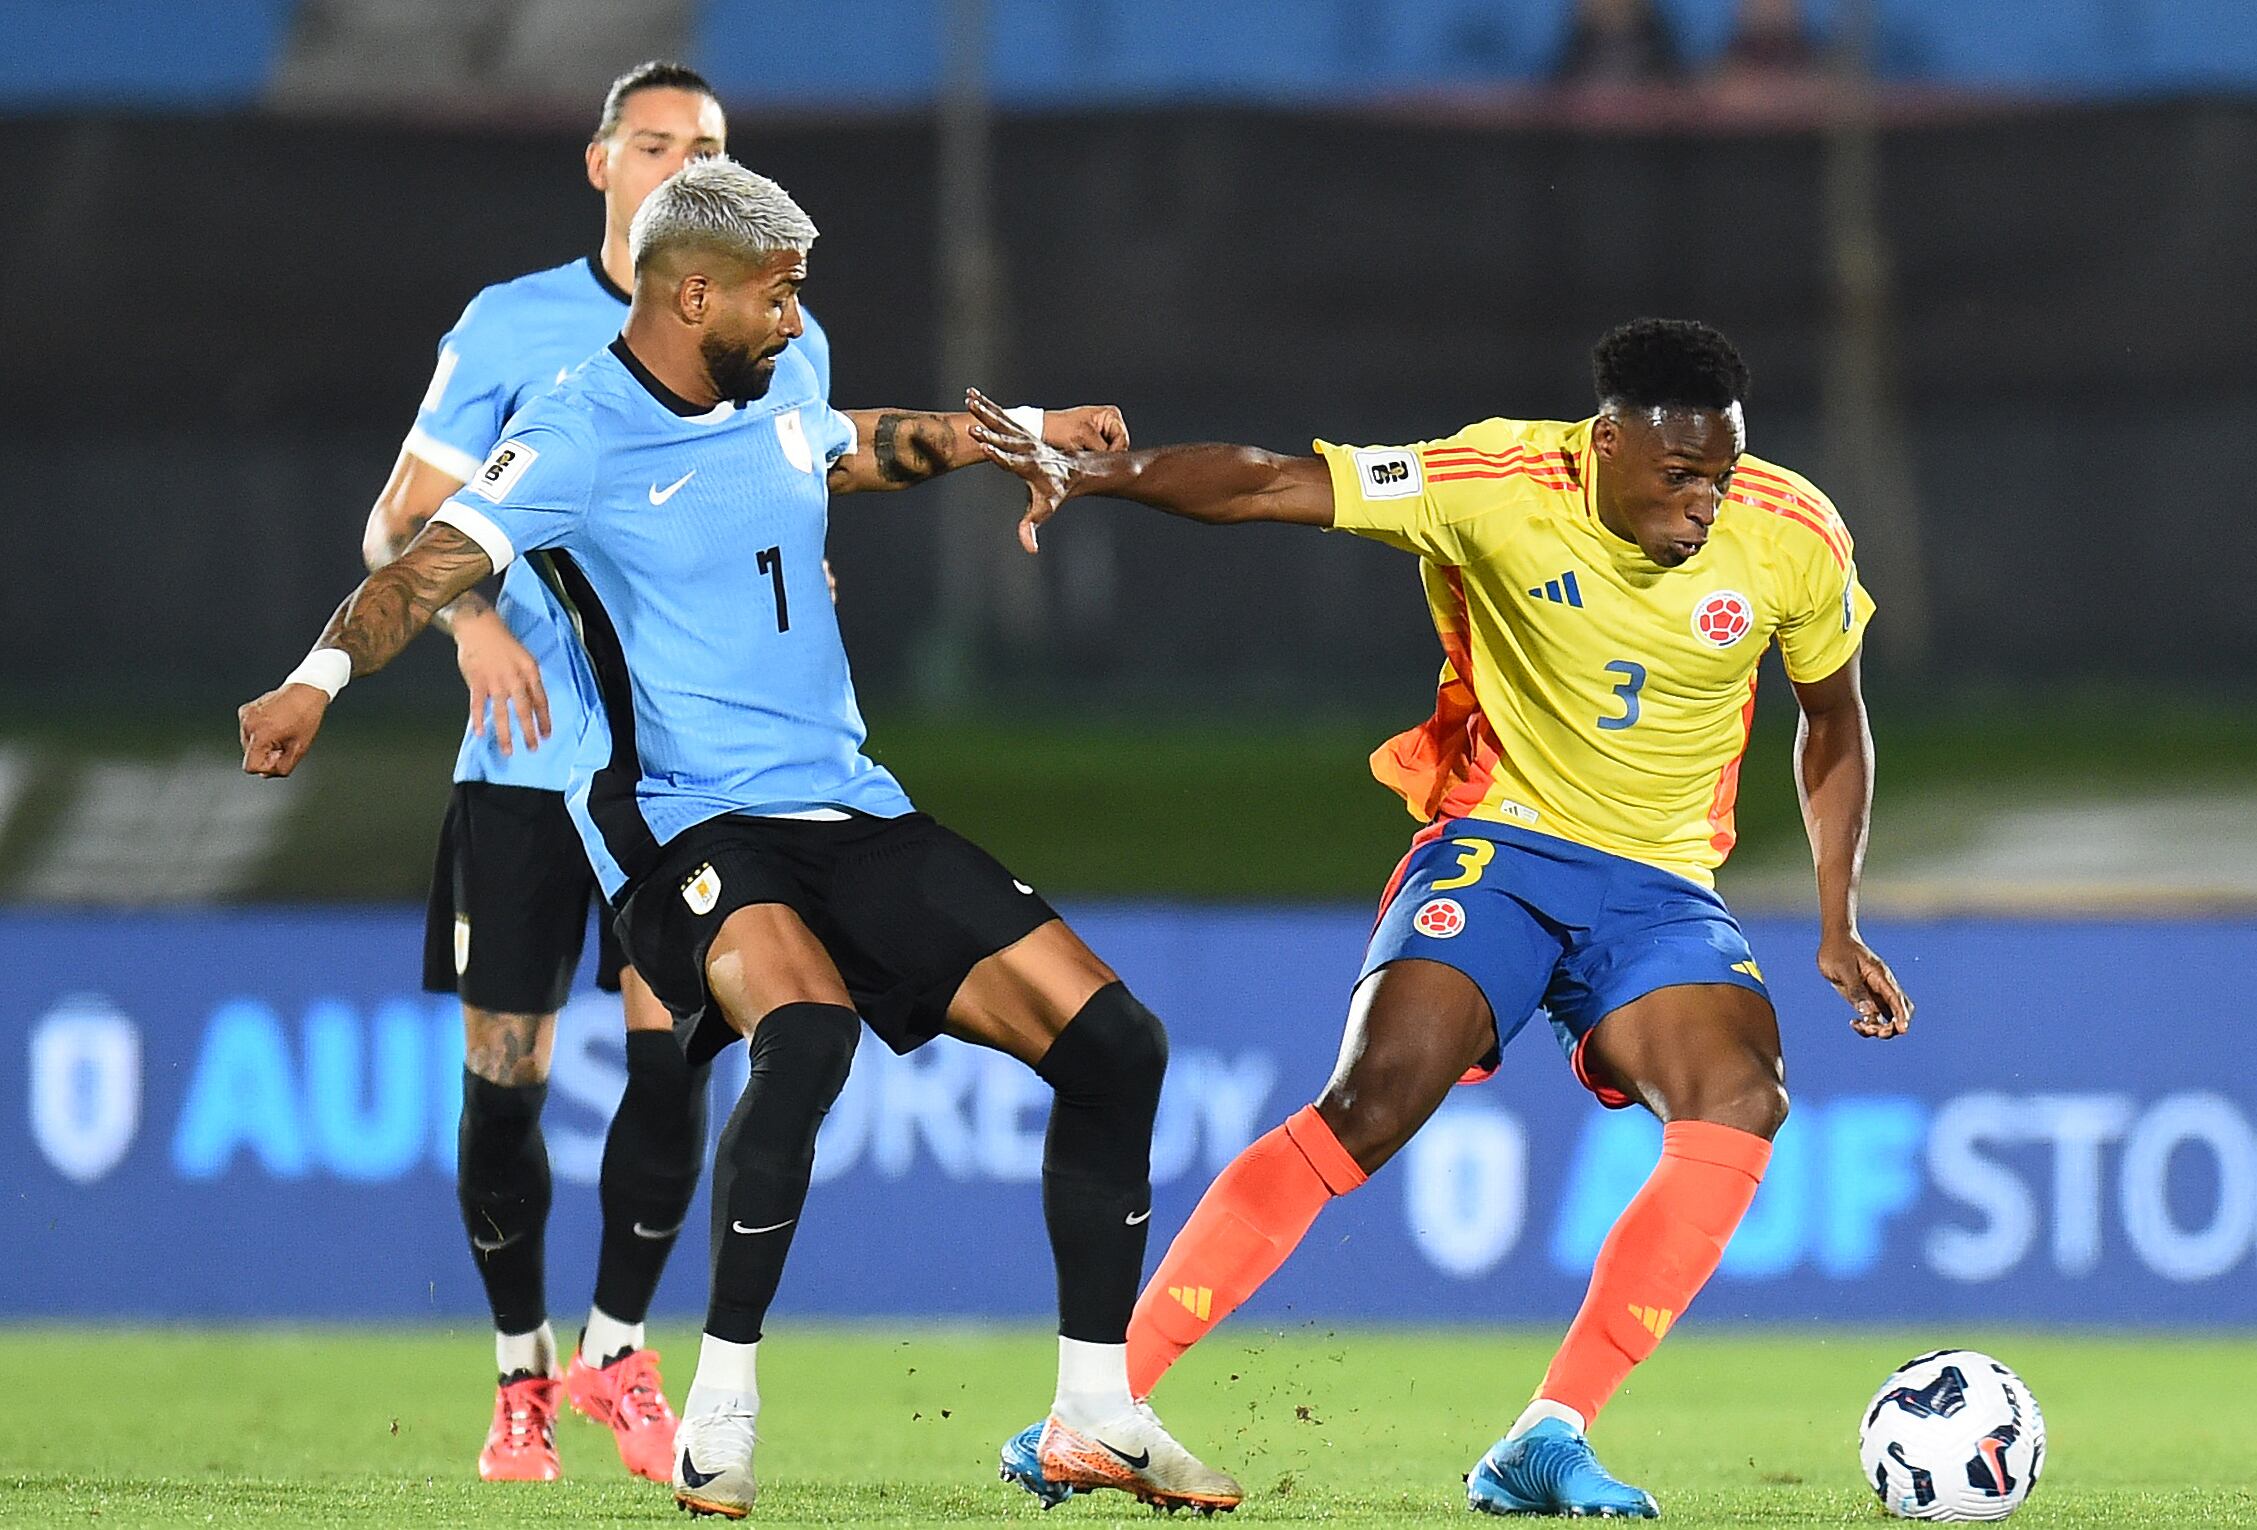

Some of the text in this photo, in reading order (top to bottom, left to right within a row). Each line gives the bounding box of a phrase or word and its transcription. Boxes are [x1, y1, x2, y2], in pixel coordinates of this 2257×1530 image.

[755, 545, 790, 634] 7
[1597, 659, 1647, 730] 3
[1430, 838, 1495, 890] 3
